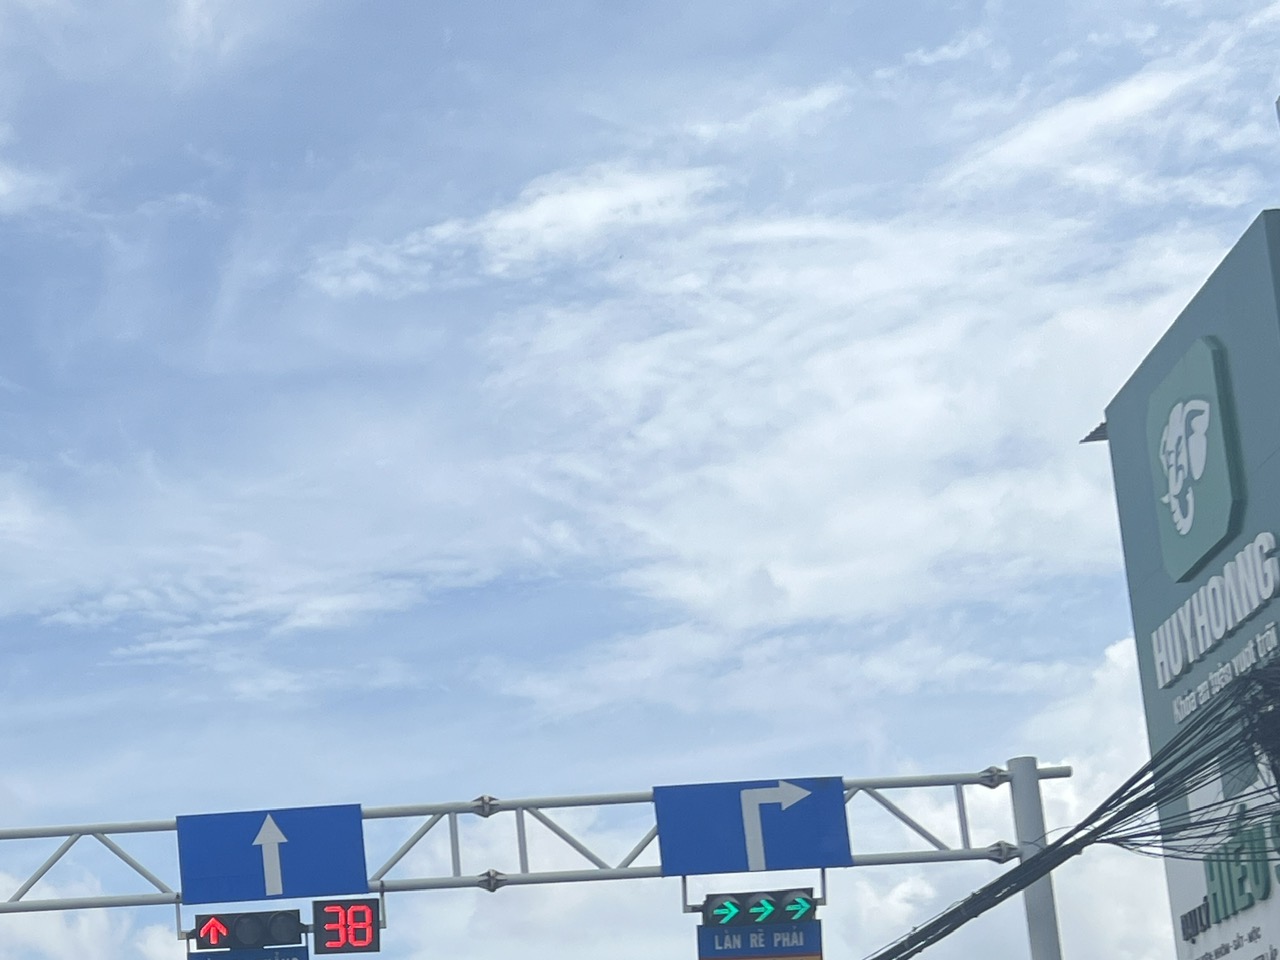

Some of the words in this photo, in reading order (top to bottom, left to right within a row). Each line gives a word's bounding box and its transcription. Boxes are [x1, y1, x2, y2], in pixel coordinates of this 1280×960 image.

[324, 905, 373, 948] 38
[714, 930, 741, 950] LÀN
[750, 929, 765, 948] RẼ
[774, 926, 804, 947] PHẢI
